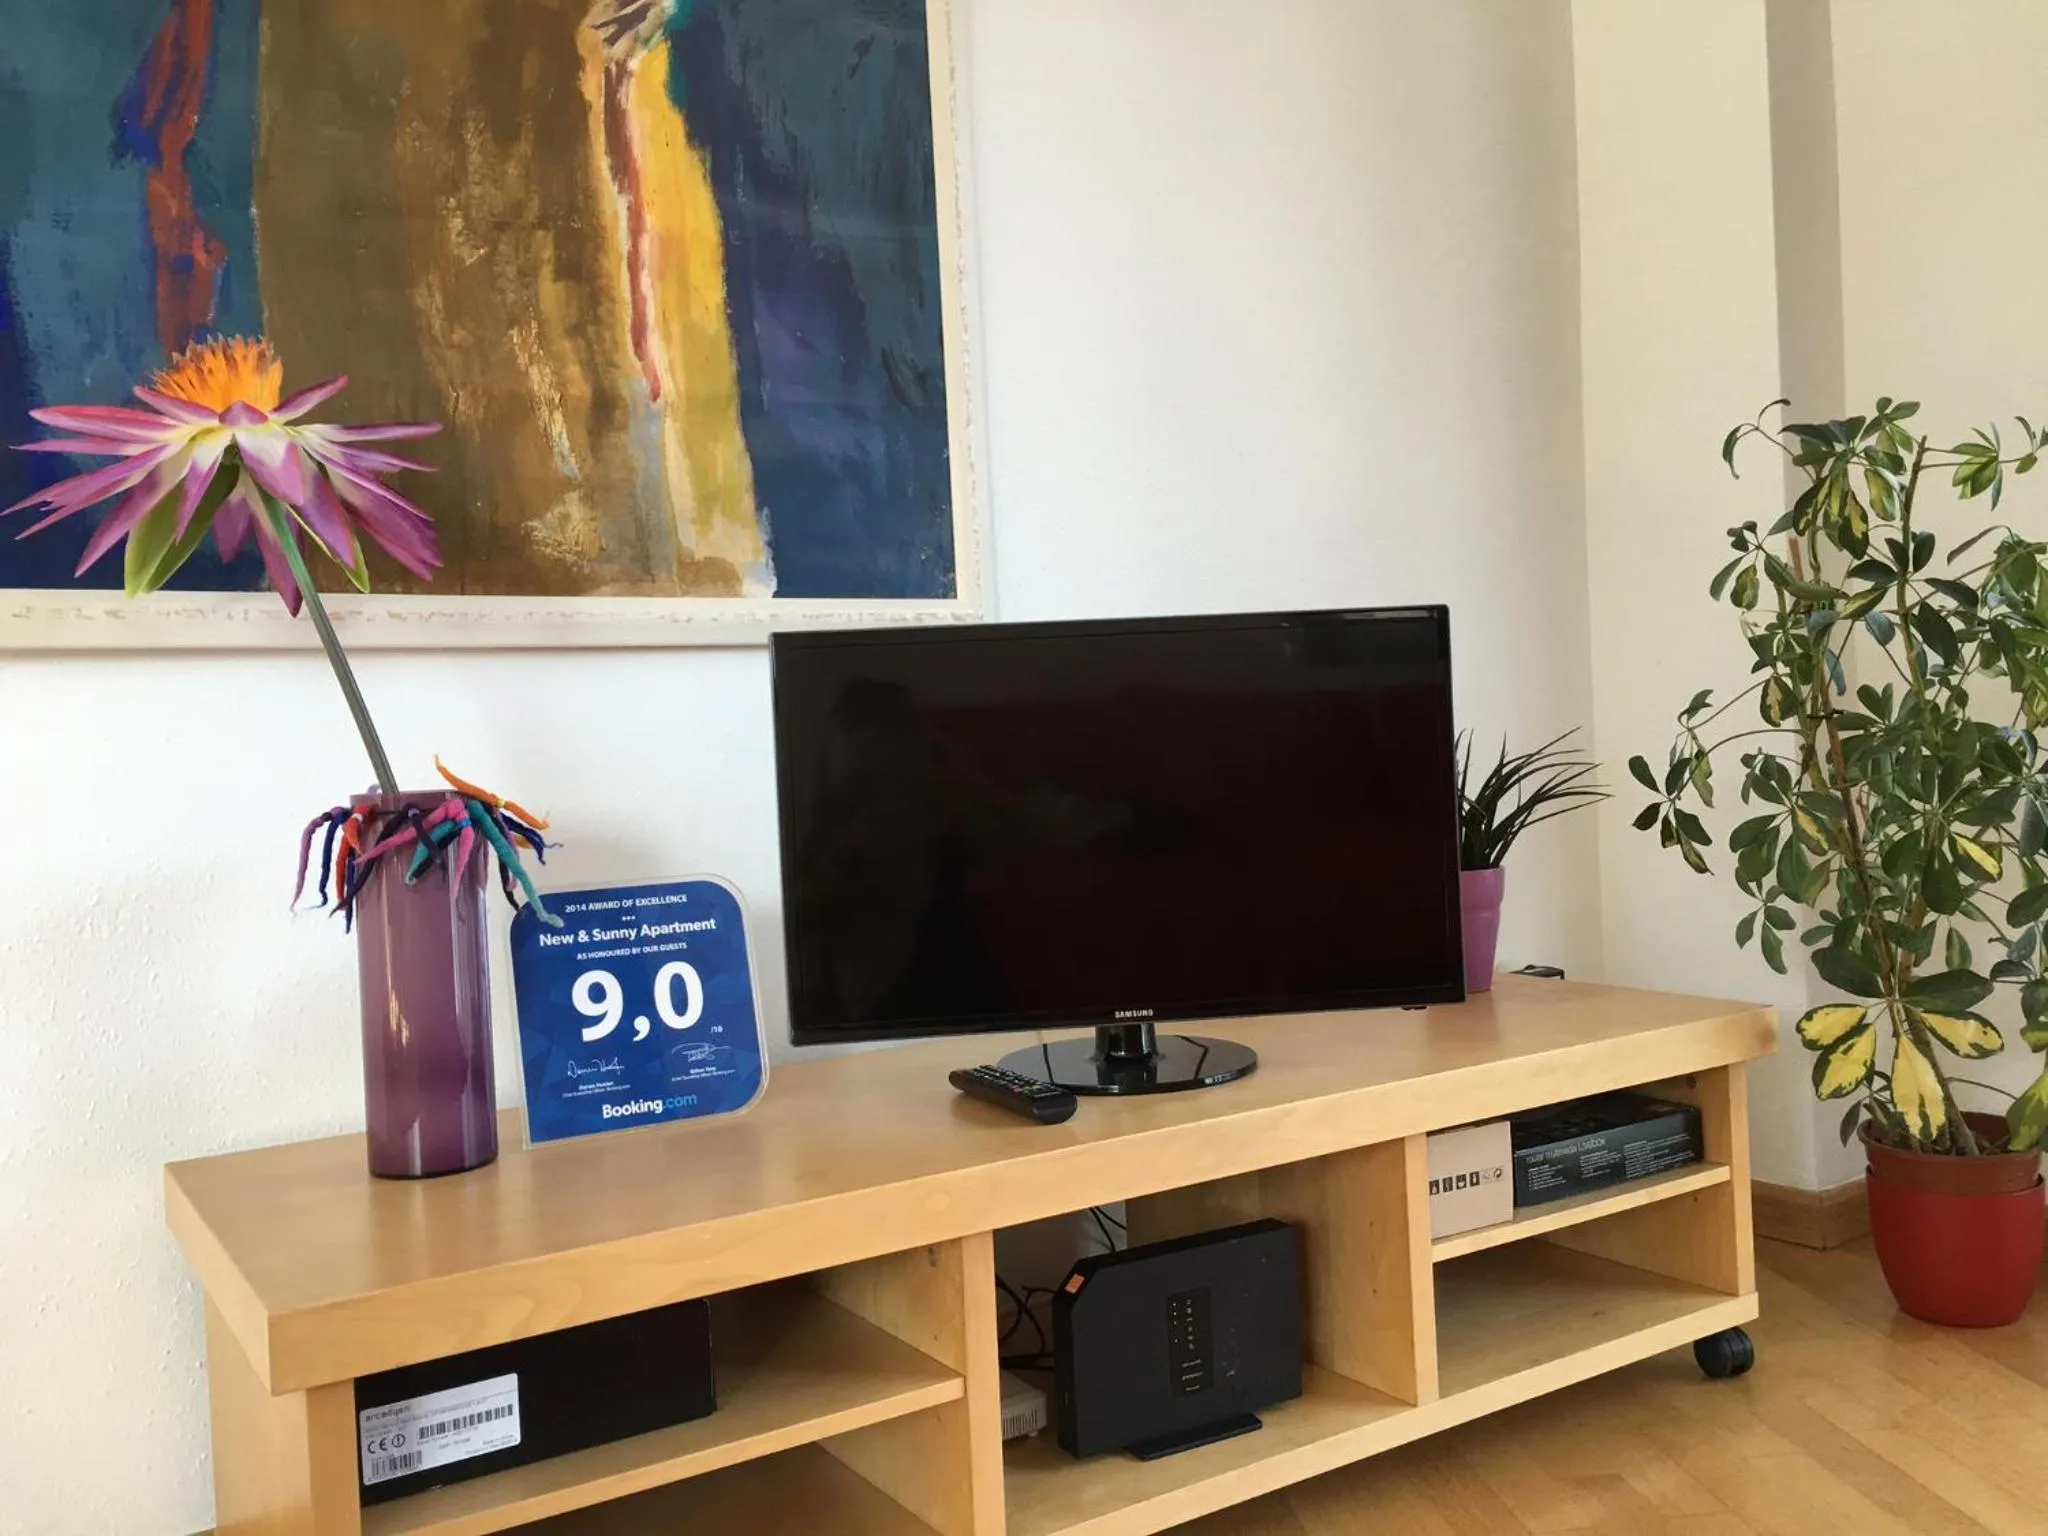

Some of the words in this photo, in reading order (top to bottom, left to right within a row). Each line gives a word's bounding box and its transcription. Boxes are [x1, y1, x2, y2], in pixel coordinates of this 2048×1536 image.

[565, 903, 587, 913] 2014
[587, 900, 621, 911] AWARD
[621, 899, 634, 908] OF
[635, 894, 688, 906] EXCELLENCE
[539, 931, 574, 947] New
[577, 929, 590, 943] &
[592, 926, 637, 941] Sunny
[640, 918, 717, 938] Apartment
[576, 952, 588, 960] AS
[588, 947, 631, 959] HONOURED
[631, 946, 641, 954] BY
[642, 944, 659, 953] OUR
[659, 941, 688, 952] GUESTS
[571, 960, 704, 1043] 9,0
[1114, 1008, 1154, 1019] SAMSUNG
[602, 1093, 698, 1119] Booking.com
